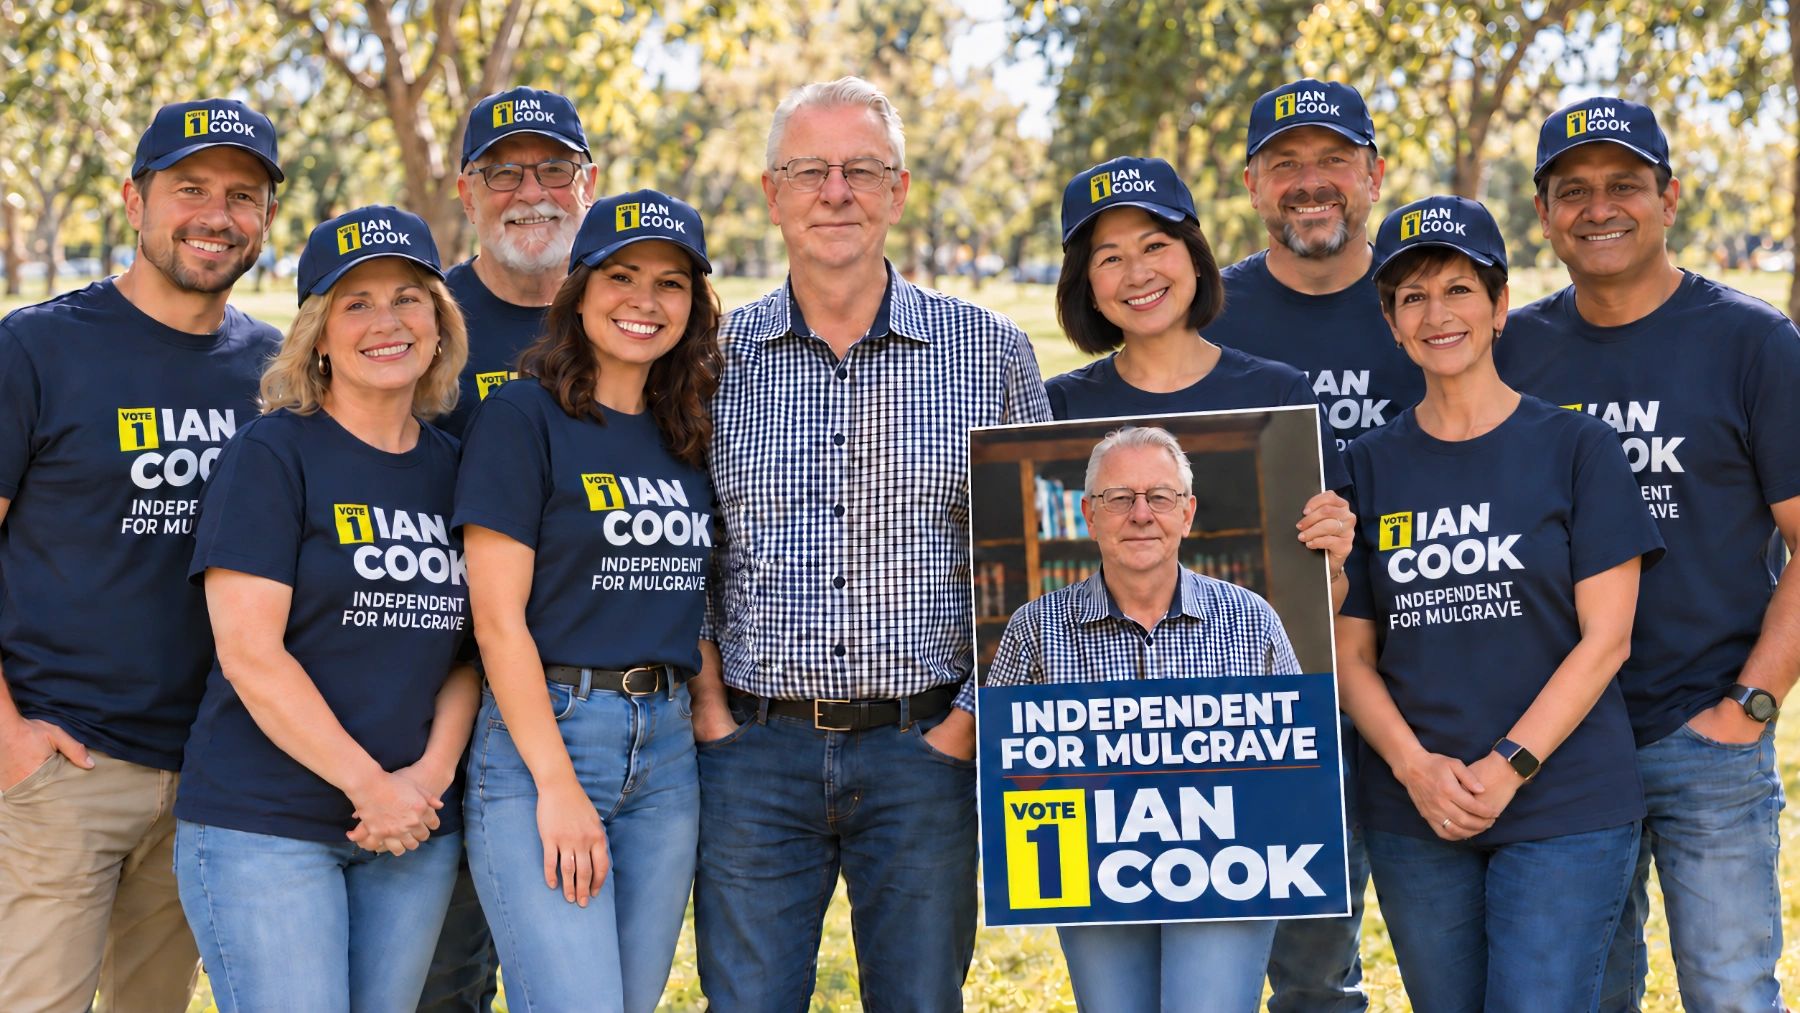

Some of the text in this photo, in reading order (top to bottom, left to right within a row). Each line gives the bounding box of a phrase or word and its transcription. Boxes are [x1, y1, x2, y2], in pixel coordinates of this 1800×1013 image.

[515, 99, 541, 111] IAN
[1296, 90, 1326, 103] IAN
[211, 109, 240, 121] IAN
[498, 108, 508, 124] 1
[514, 110, 556, 124] COOK
[1280, 101, 1289, 116] 1
[1296, 102, 1340, 117] COOK
[1588, 106, 1616, 120] IAN
[190, 118, 200, 134] 1
[209, 121, 256, 138] COOK
[1571, 118, 1581, 133] 1
[1587, 120, 1632, 134] COOK
[1111, 168, 1141, 182] IAN
[1094, 182, 1106, 198] 1
[1111, 180, 1157, 194] COOK
[641, 202, 670, 216] IAN
[1422, 207, 1451, 221] IAN
[361, 219, 392, 233] IAN
[622, 211, 632, 228] 1
[640, 215, 686, 234] COOK
[1406, 219, 1416, 236] 1
[1421, 220, 1466, 237] COOK
[342, 232, 354, 250] 1
[361, 232, 412, 246] COOK
[1304, 370, 1370, 396] AN
[121, 412, 153, 421] VOTE
[1321, 398, 1392, 430] OK
[161, 408, 237, 442] IAN
[132, 422, 146, 447] 1
[1622, 437, 1686, 473] OK
[130, 447, 223, 490] COO
[586, 476, 615, 484] VOTE
[598, 484, 614, 508] 1
[620, 476, 690, 508] IAN
[131, 499, 199, 516] INDEPE
[338, 506, 366, 516] VOTE
[121, 518, 158, 535] FOR
[347, 516, 363, 541] 1
[373, 506, 450, 546] IAN
[603, 509, 713, 548] COOK
[1383, 516, 1409, 525] VOTE
[1416, 502, 1491, 542] IAN
[1389, 525, 1400, 547] 1
[353, 545, 470, 587] COOK
[601, 556, 703, 573] INDEPENDENT
[1387, 534, 1526, 584] COOK
[592, 574, 706, 591] FOR MULGRAVE
[352, 591, 465, 613] INDEPENDENT
[1394, 581, 1514, 611] INDEPENDENT
[342, 610, 465, 631] FOR MULGRAVE
[1389, 600, 1523, 630] FOR MULGRAVE
[1010, 691, 1301, 734] INDEPENDENT
[1000, 727, 1318, 770] FOR MULGRAVE
[1010, 801, 1077, 821] VOTE
[1094, 785, 1236, 844] IAN
[1026, 824, 1063, 900] 1
[1097, 843, 1327, 904] COOK
